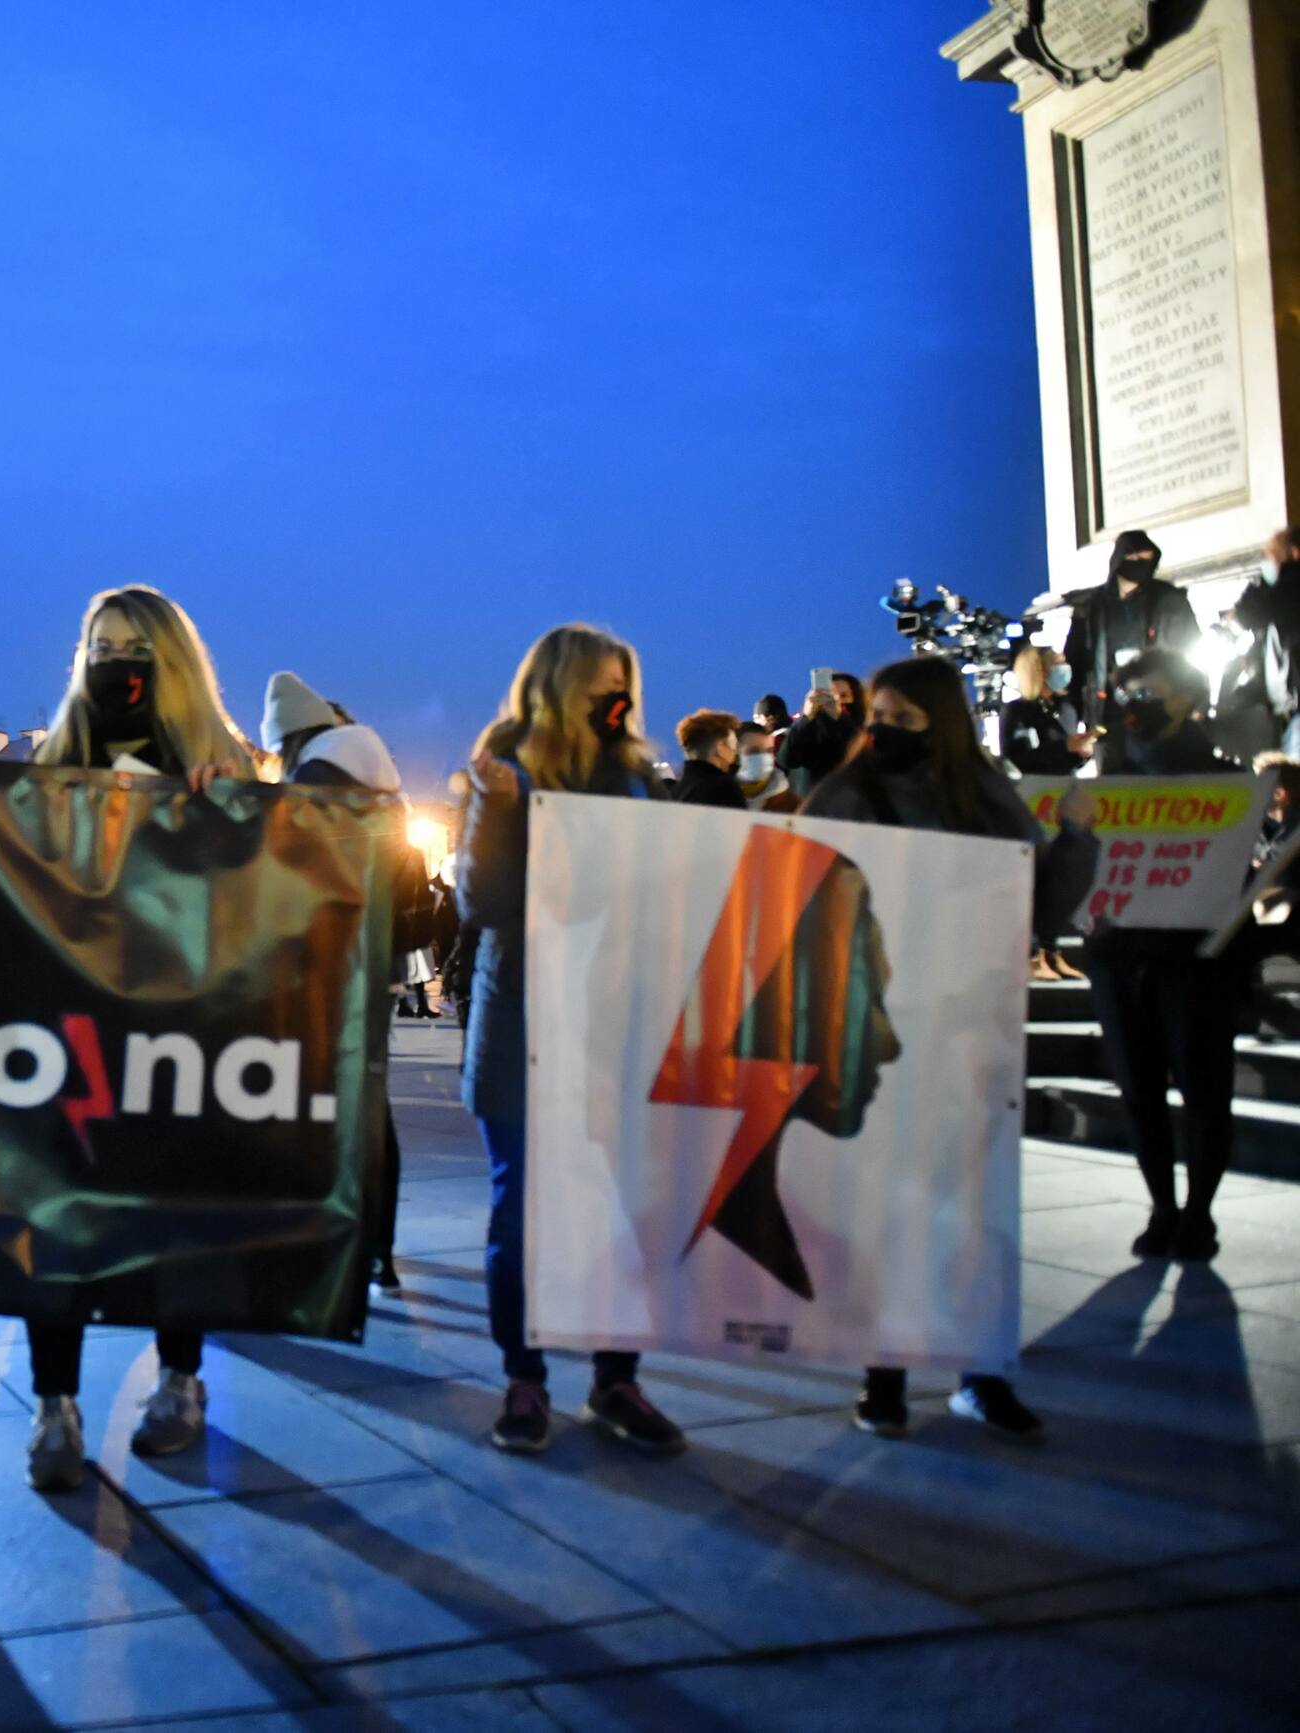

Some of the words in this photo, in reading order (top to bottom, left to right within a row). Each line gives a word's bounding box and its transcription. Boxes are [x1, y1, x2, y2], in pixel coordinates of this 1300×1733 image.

[1092, 159, 1200, 223] SIGISMVNDO
[1154, 313, 1220, 348] PATRIAE
[1035, 794, 1227, 827] ROLUTION
[1108, 839, 1145, 861] DO
[1153, 838, 1211, 861] NOT
[1107, 864, 1137, 886] IS
[1146, 866, 1191, 888] NO
